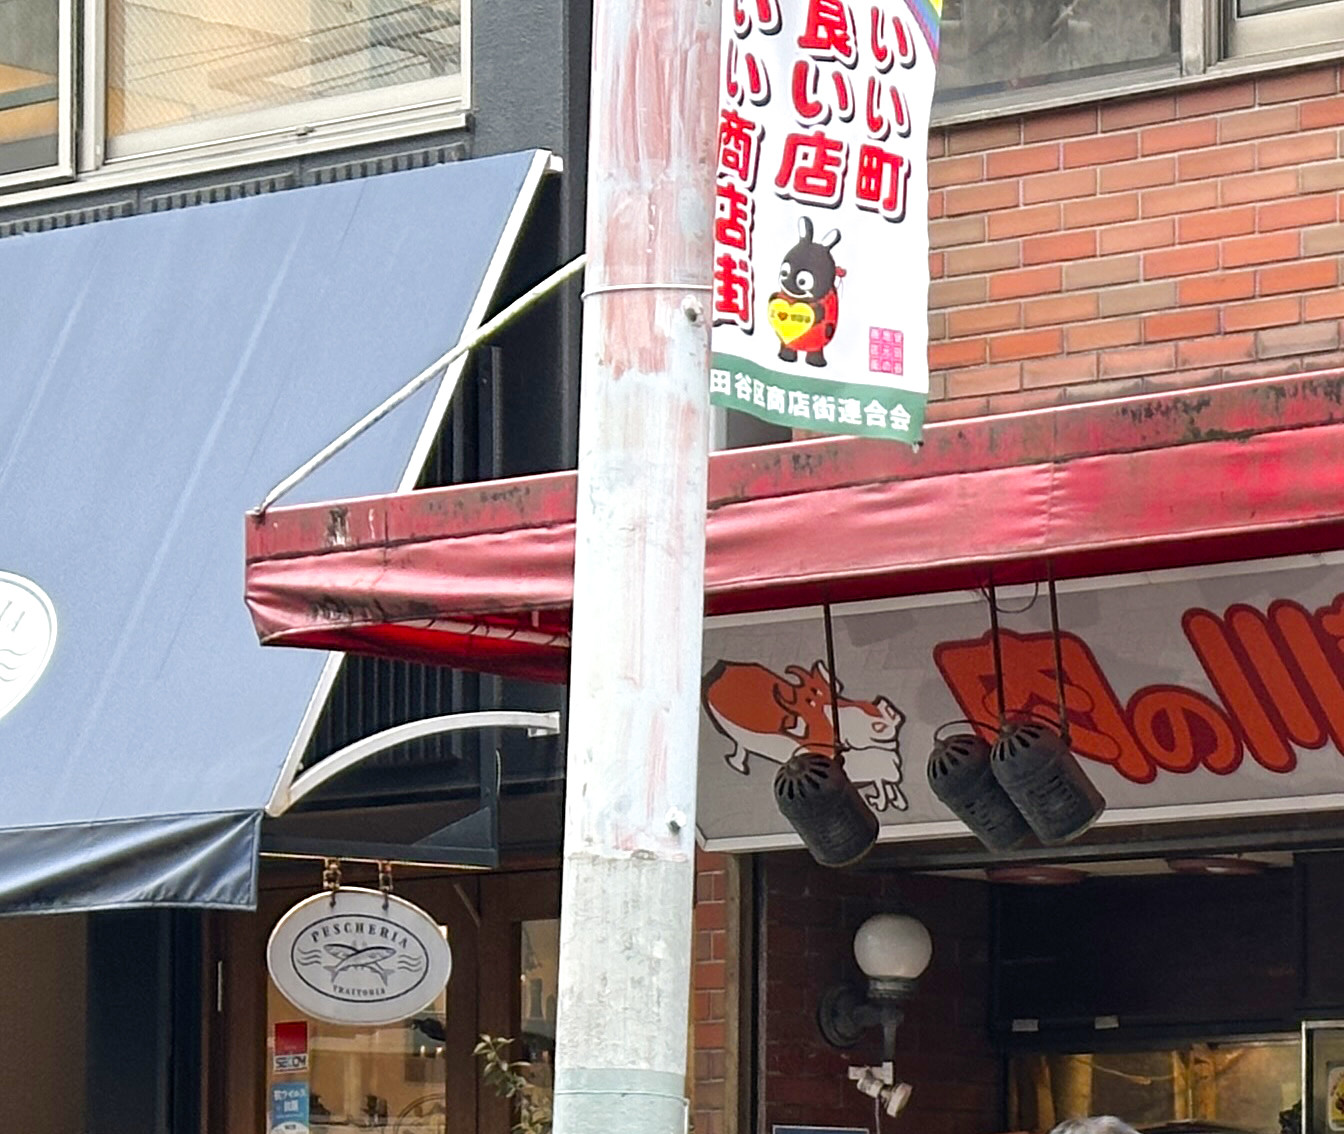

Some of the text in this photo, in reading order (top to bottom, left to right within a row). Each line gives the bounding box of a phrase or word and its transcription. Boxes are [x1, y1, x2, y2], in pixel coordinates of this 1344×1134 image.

[776, 0, 857, 208] 良い店
[855, 4, 915, 222] いい町
[311, 921, 409, 948] PESCHERIA
